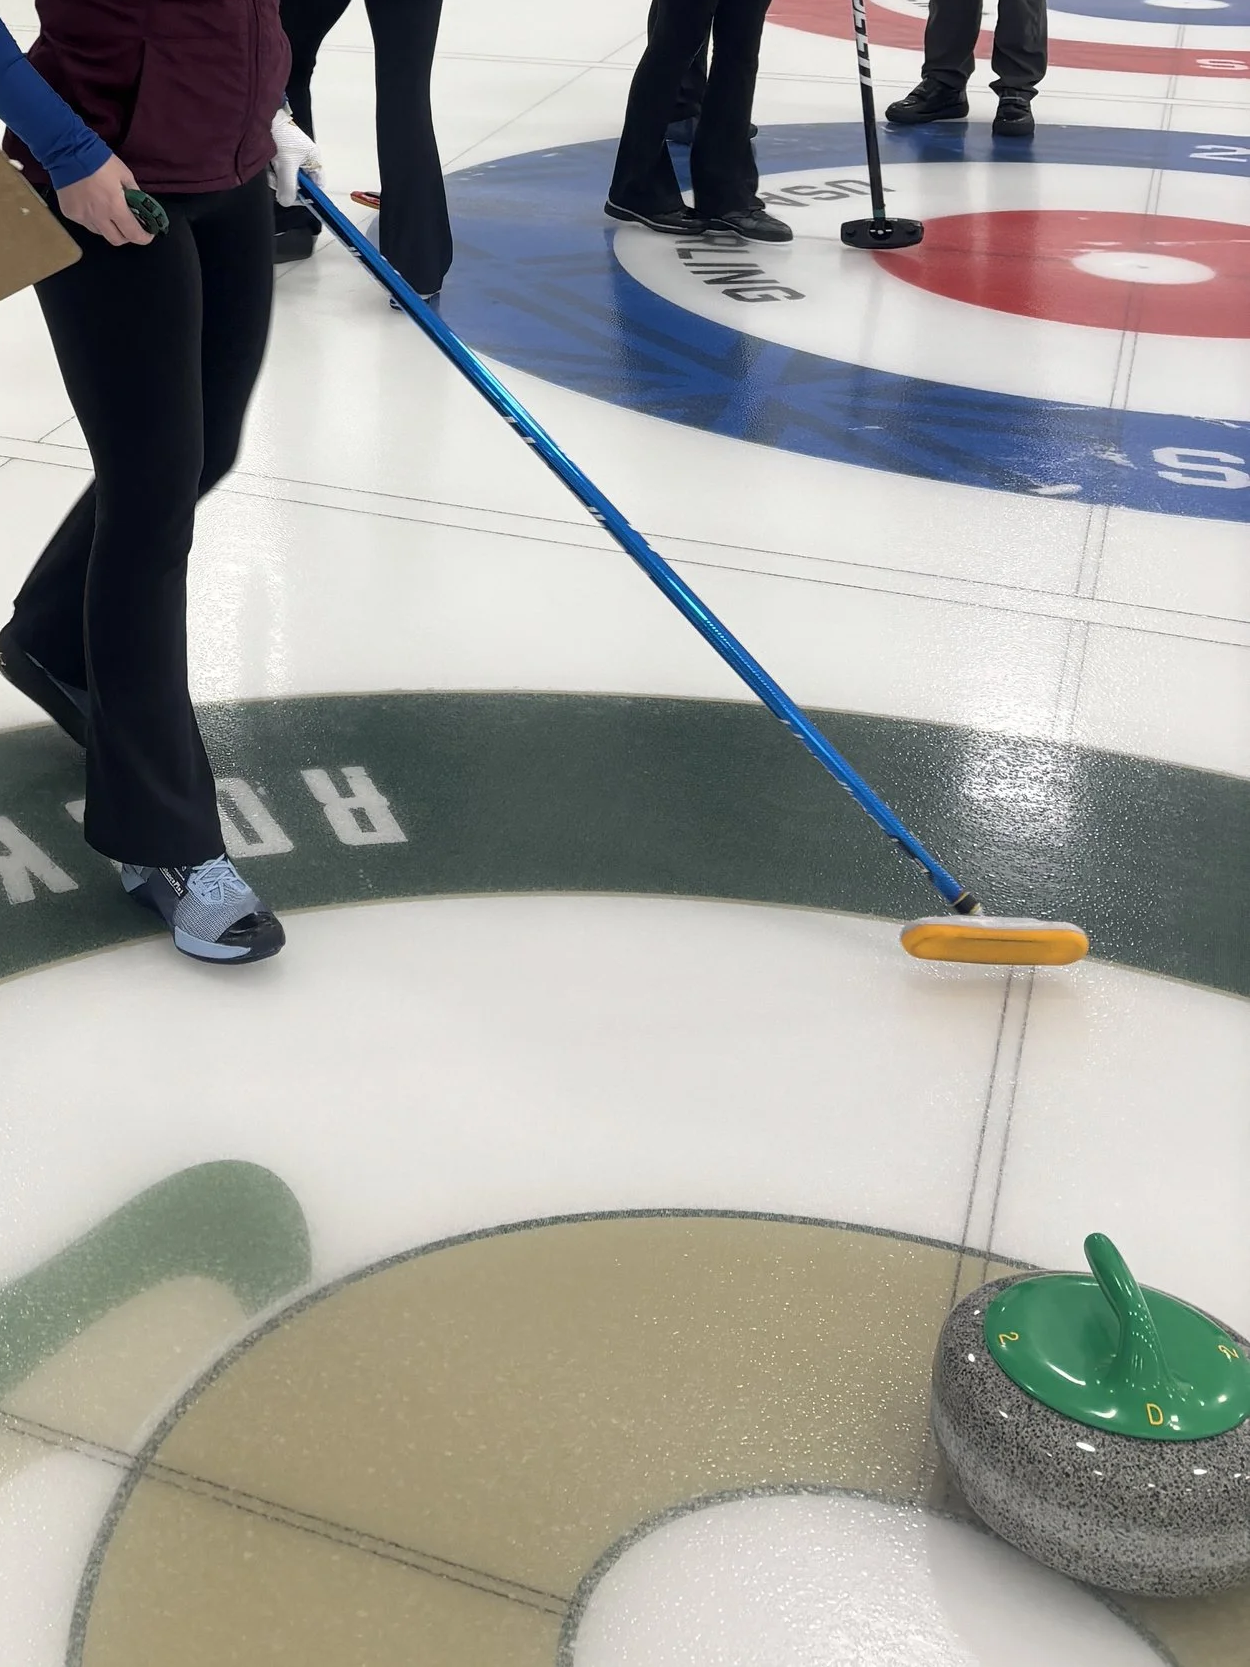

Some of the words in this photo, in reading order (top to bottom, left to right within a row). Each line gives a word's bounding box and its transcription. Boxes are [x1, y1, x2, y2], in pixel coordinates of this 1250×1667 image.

[759, 179, 896, 208] USA
[675, 230, 807, 303] RLING
[1145, 1402, 1165, 1427] D
